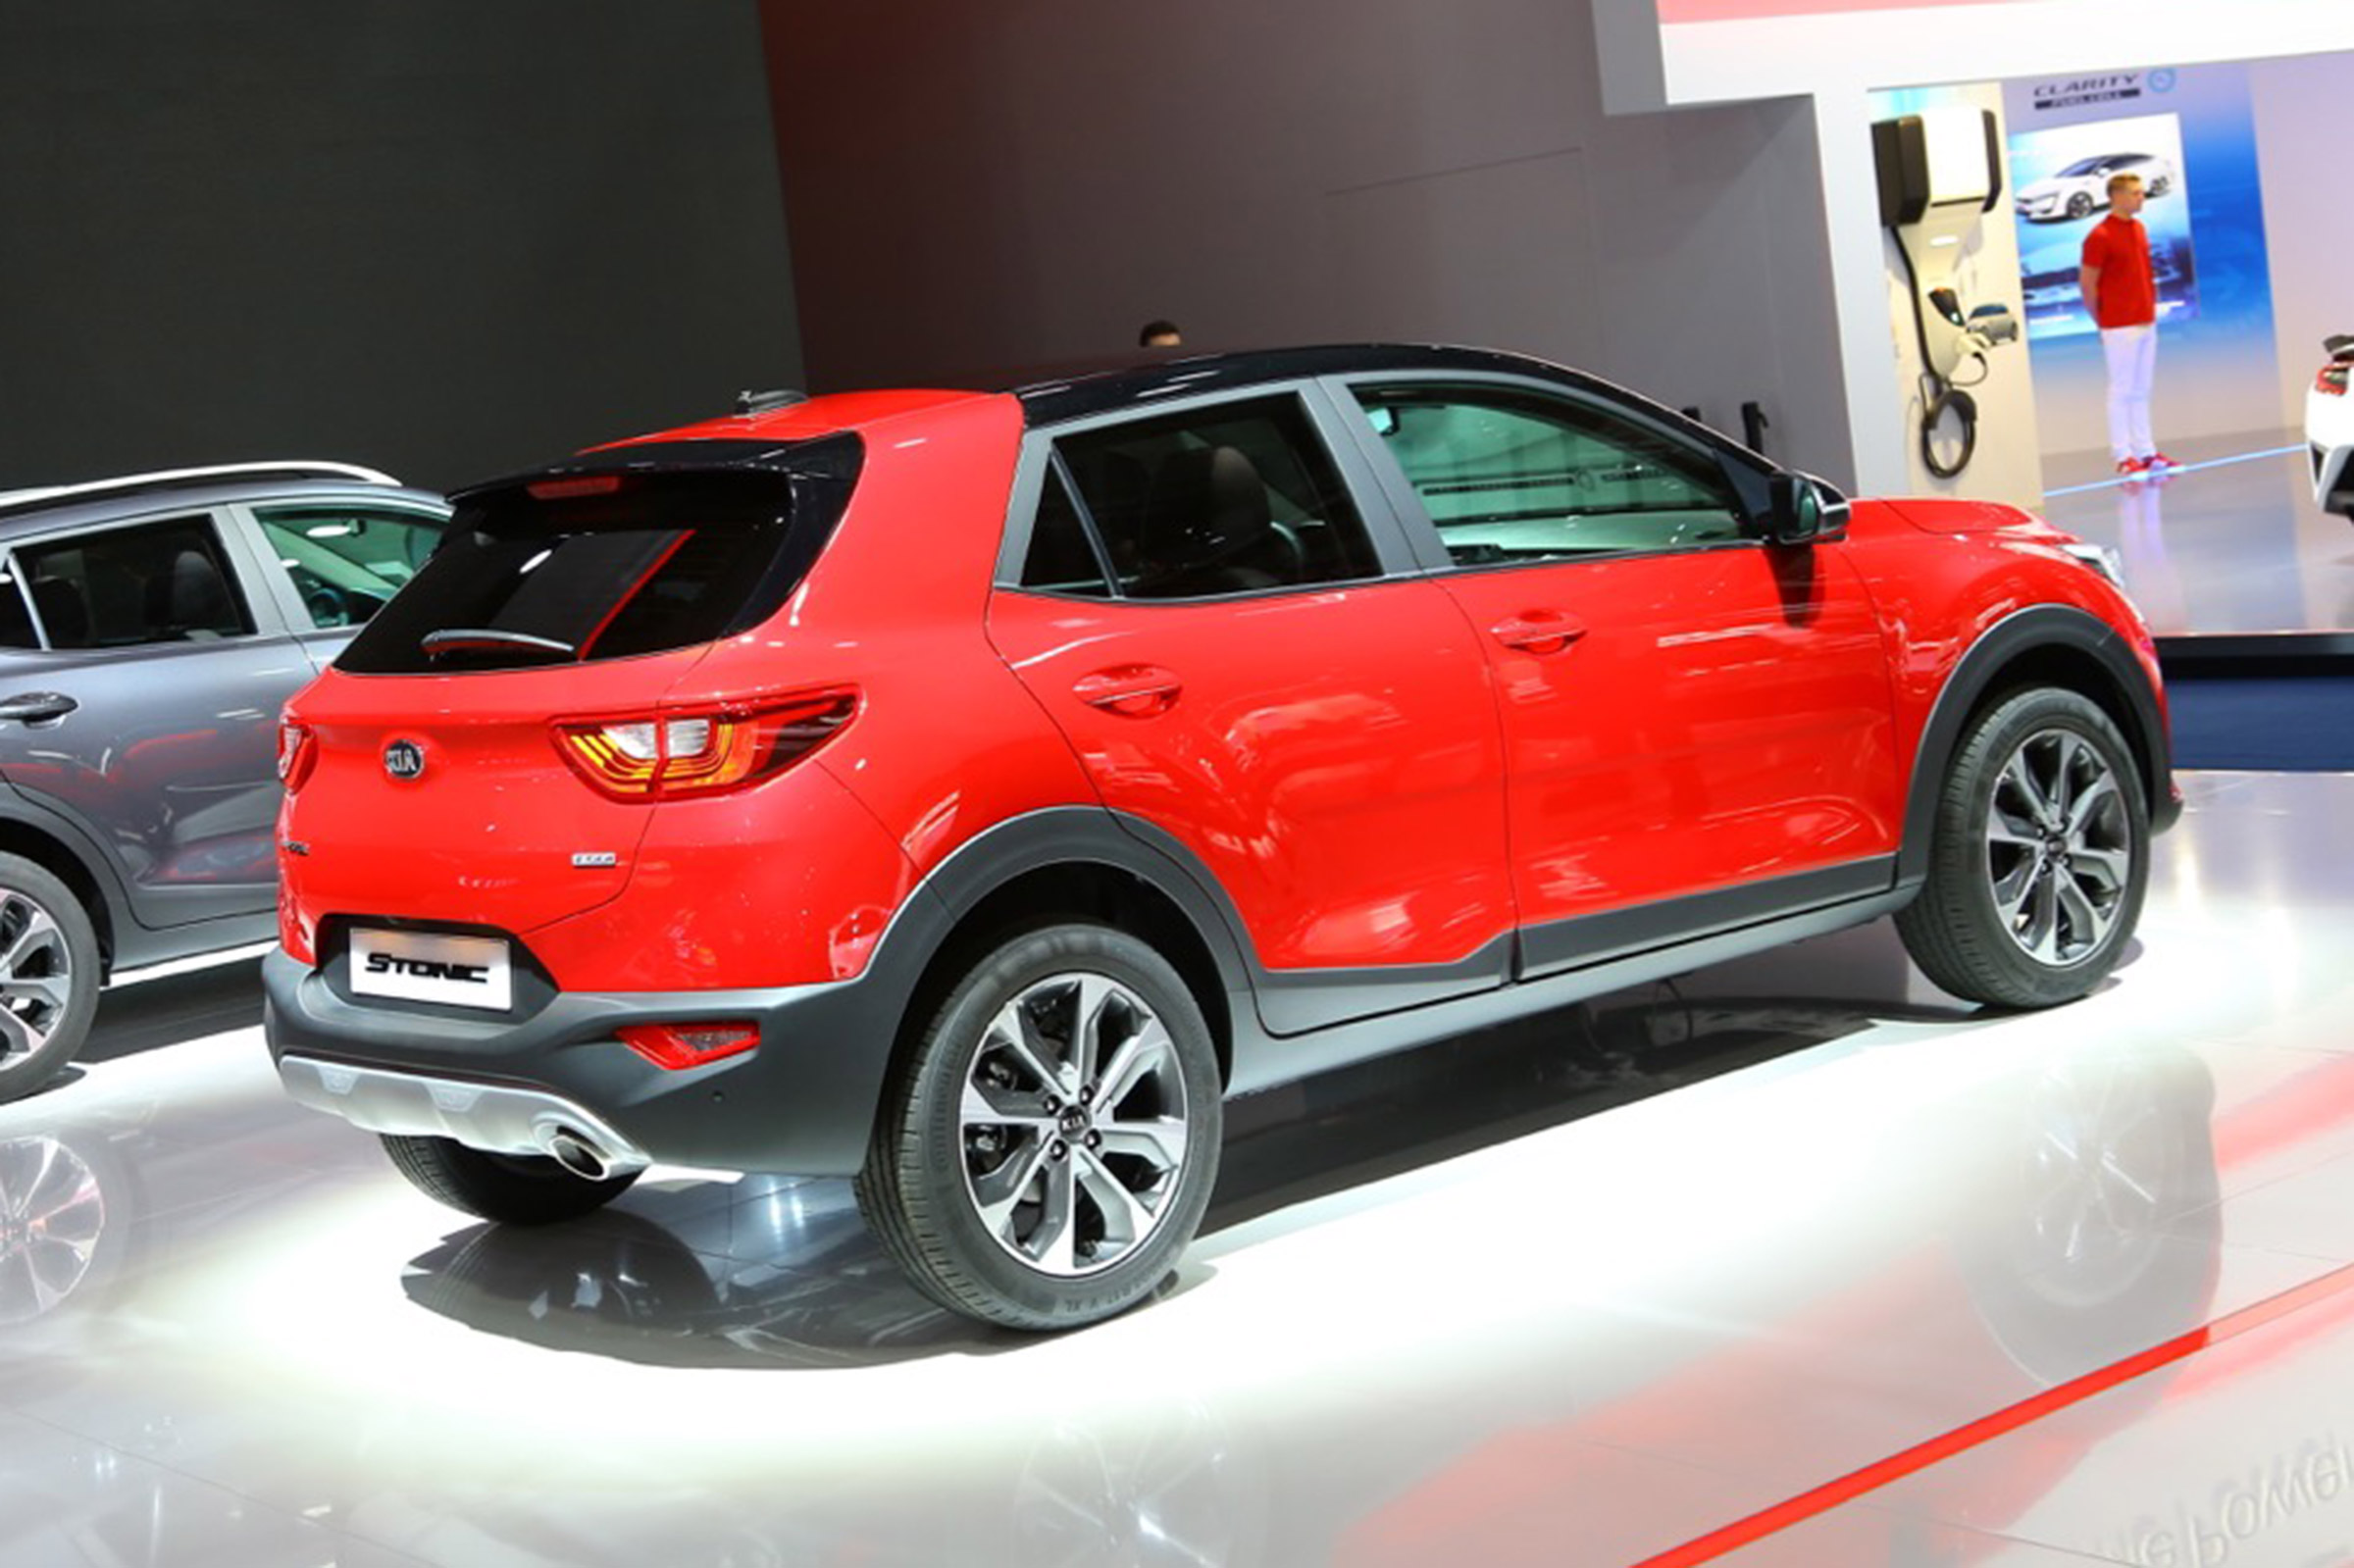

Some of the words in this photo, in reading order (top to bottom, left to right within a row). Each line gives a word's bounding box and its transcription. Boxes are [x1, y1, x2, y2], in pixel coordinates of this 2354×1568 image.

[2034, 75, 2138, 96] CLARITY
[364, 951, 489, 985] STONIC
[1061, 1114, 1086, 1132] KIA
